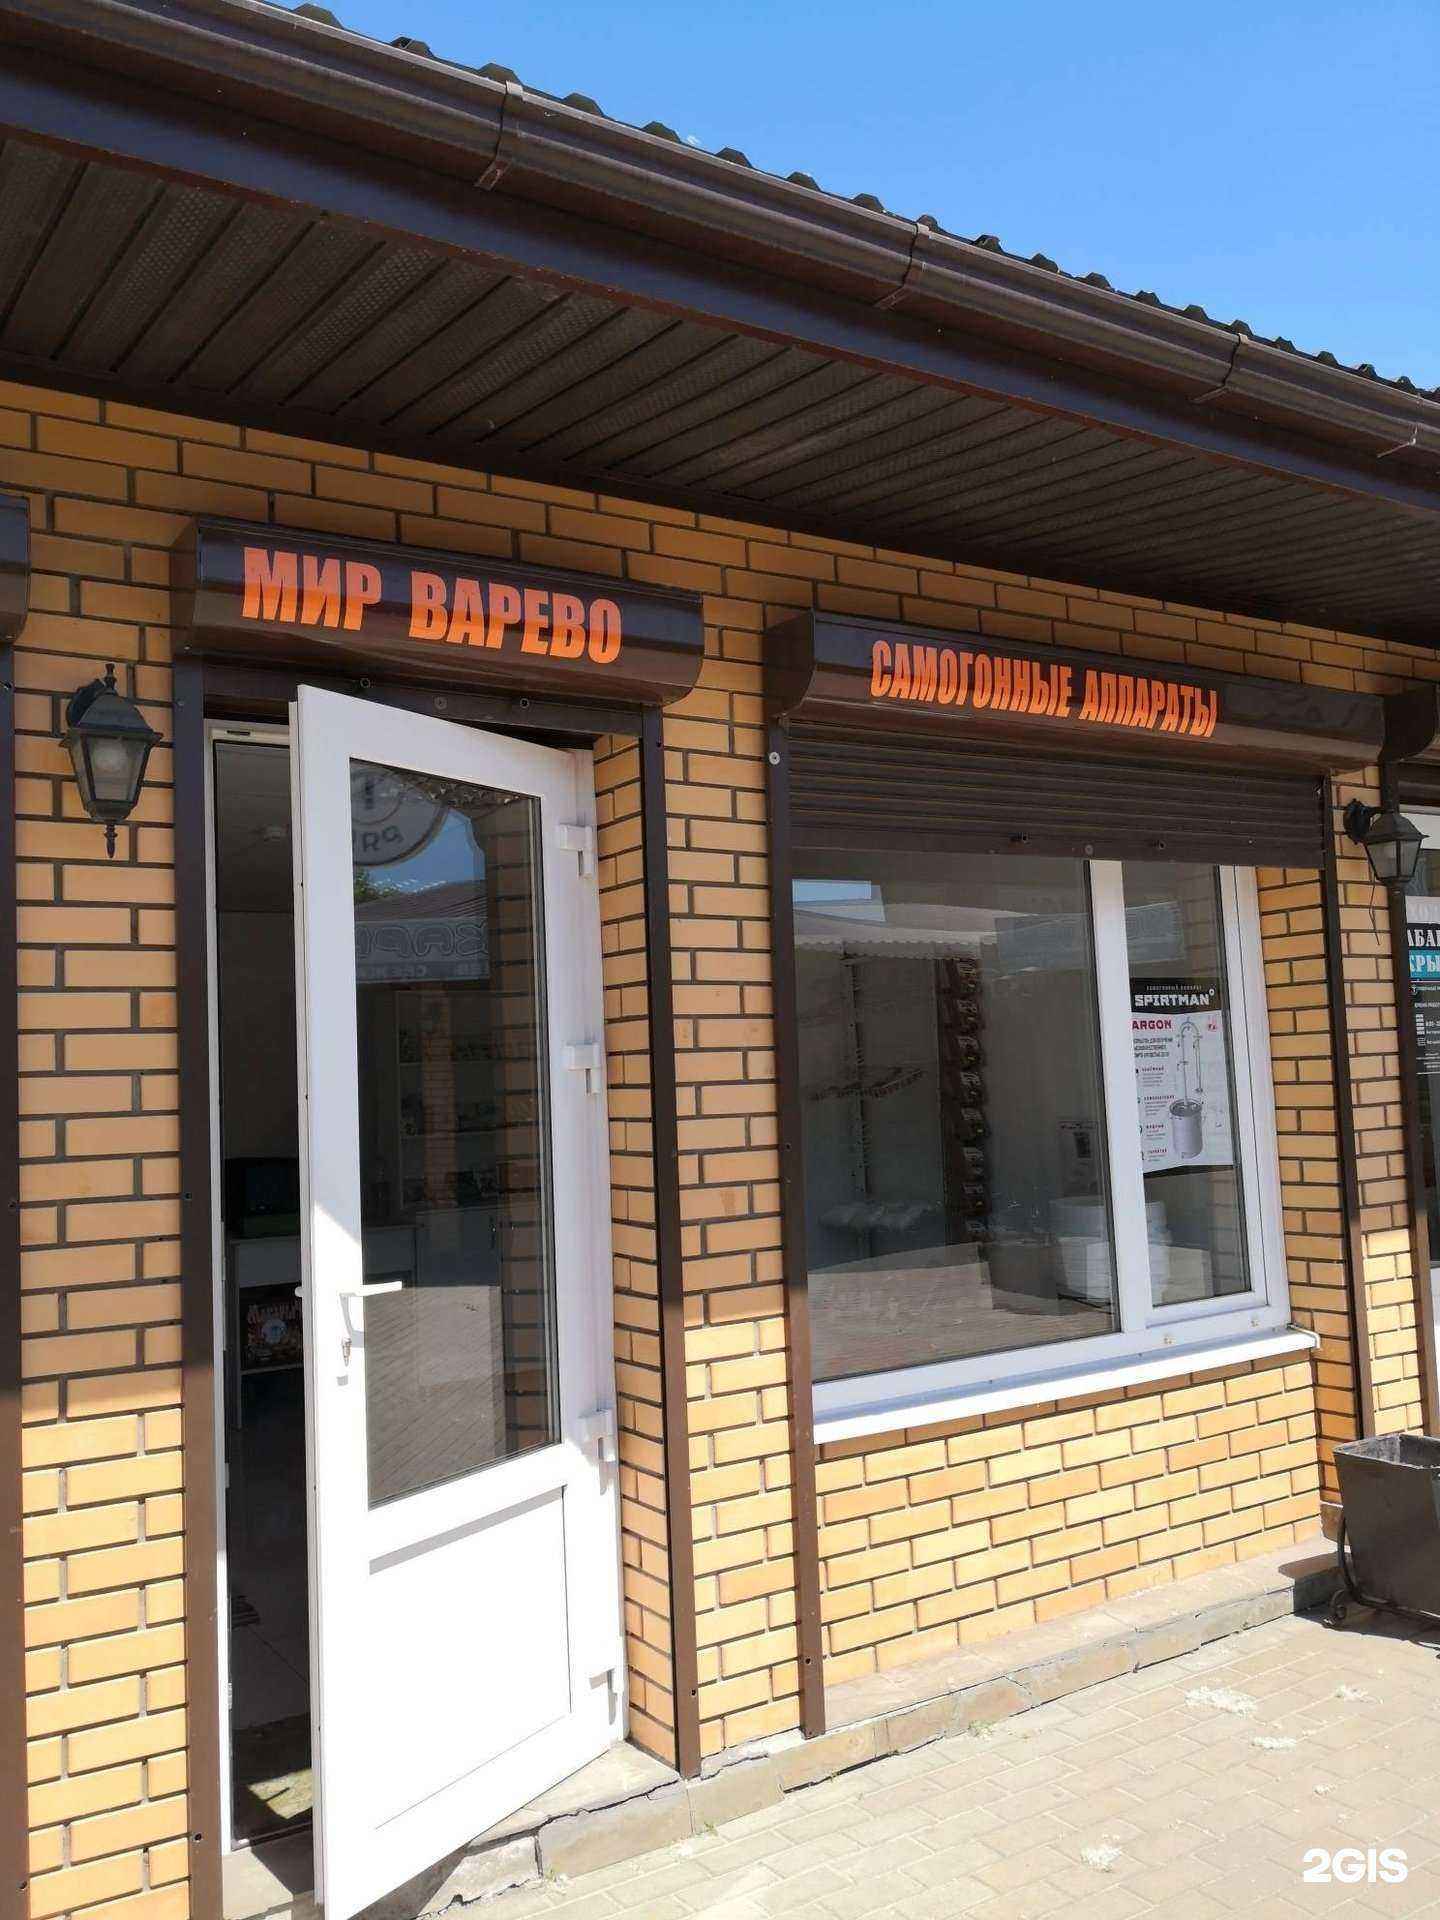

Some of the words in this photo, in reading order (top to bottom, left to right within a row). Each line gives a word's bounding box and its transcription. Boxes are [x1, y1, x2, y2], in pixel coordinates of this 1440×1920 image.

[242, 547, 382, 630] МИР
[408, 570, 623, 664] ВАРЕВО
[870, 640, 1072, 717] САМОГОННЫЕ
[1079, 670, 1218, 738] АППАРАТЫ
[1131, 1020, 1172, 1030] ARGON
